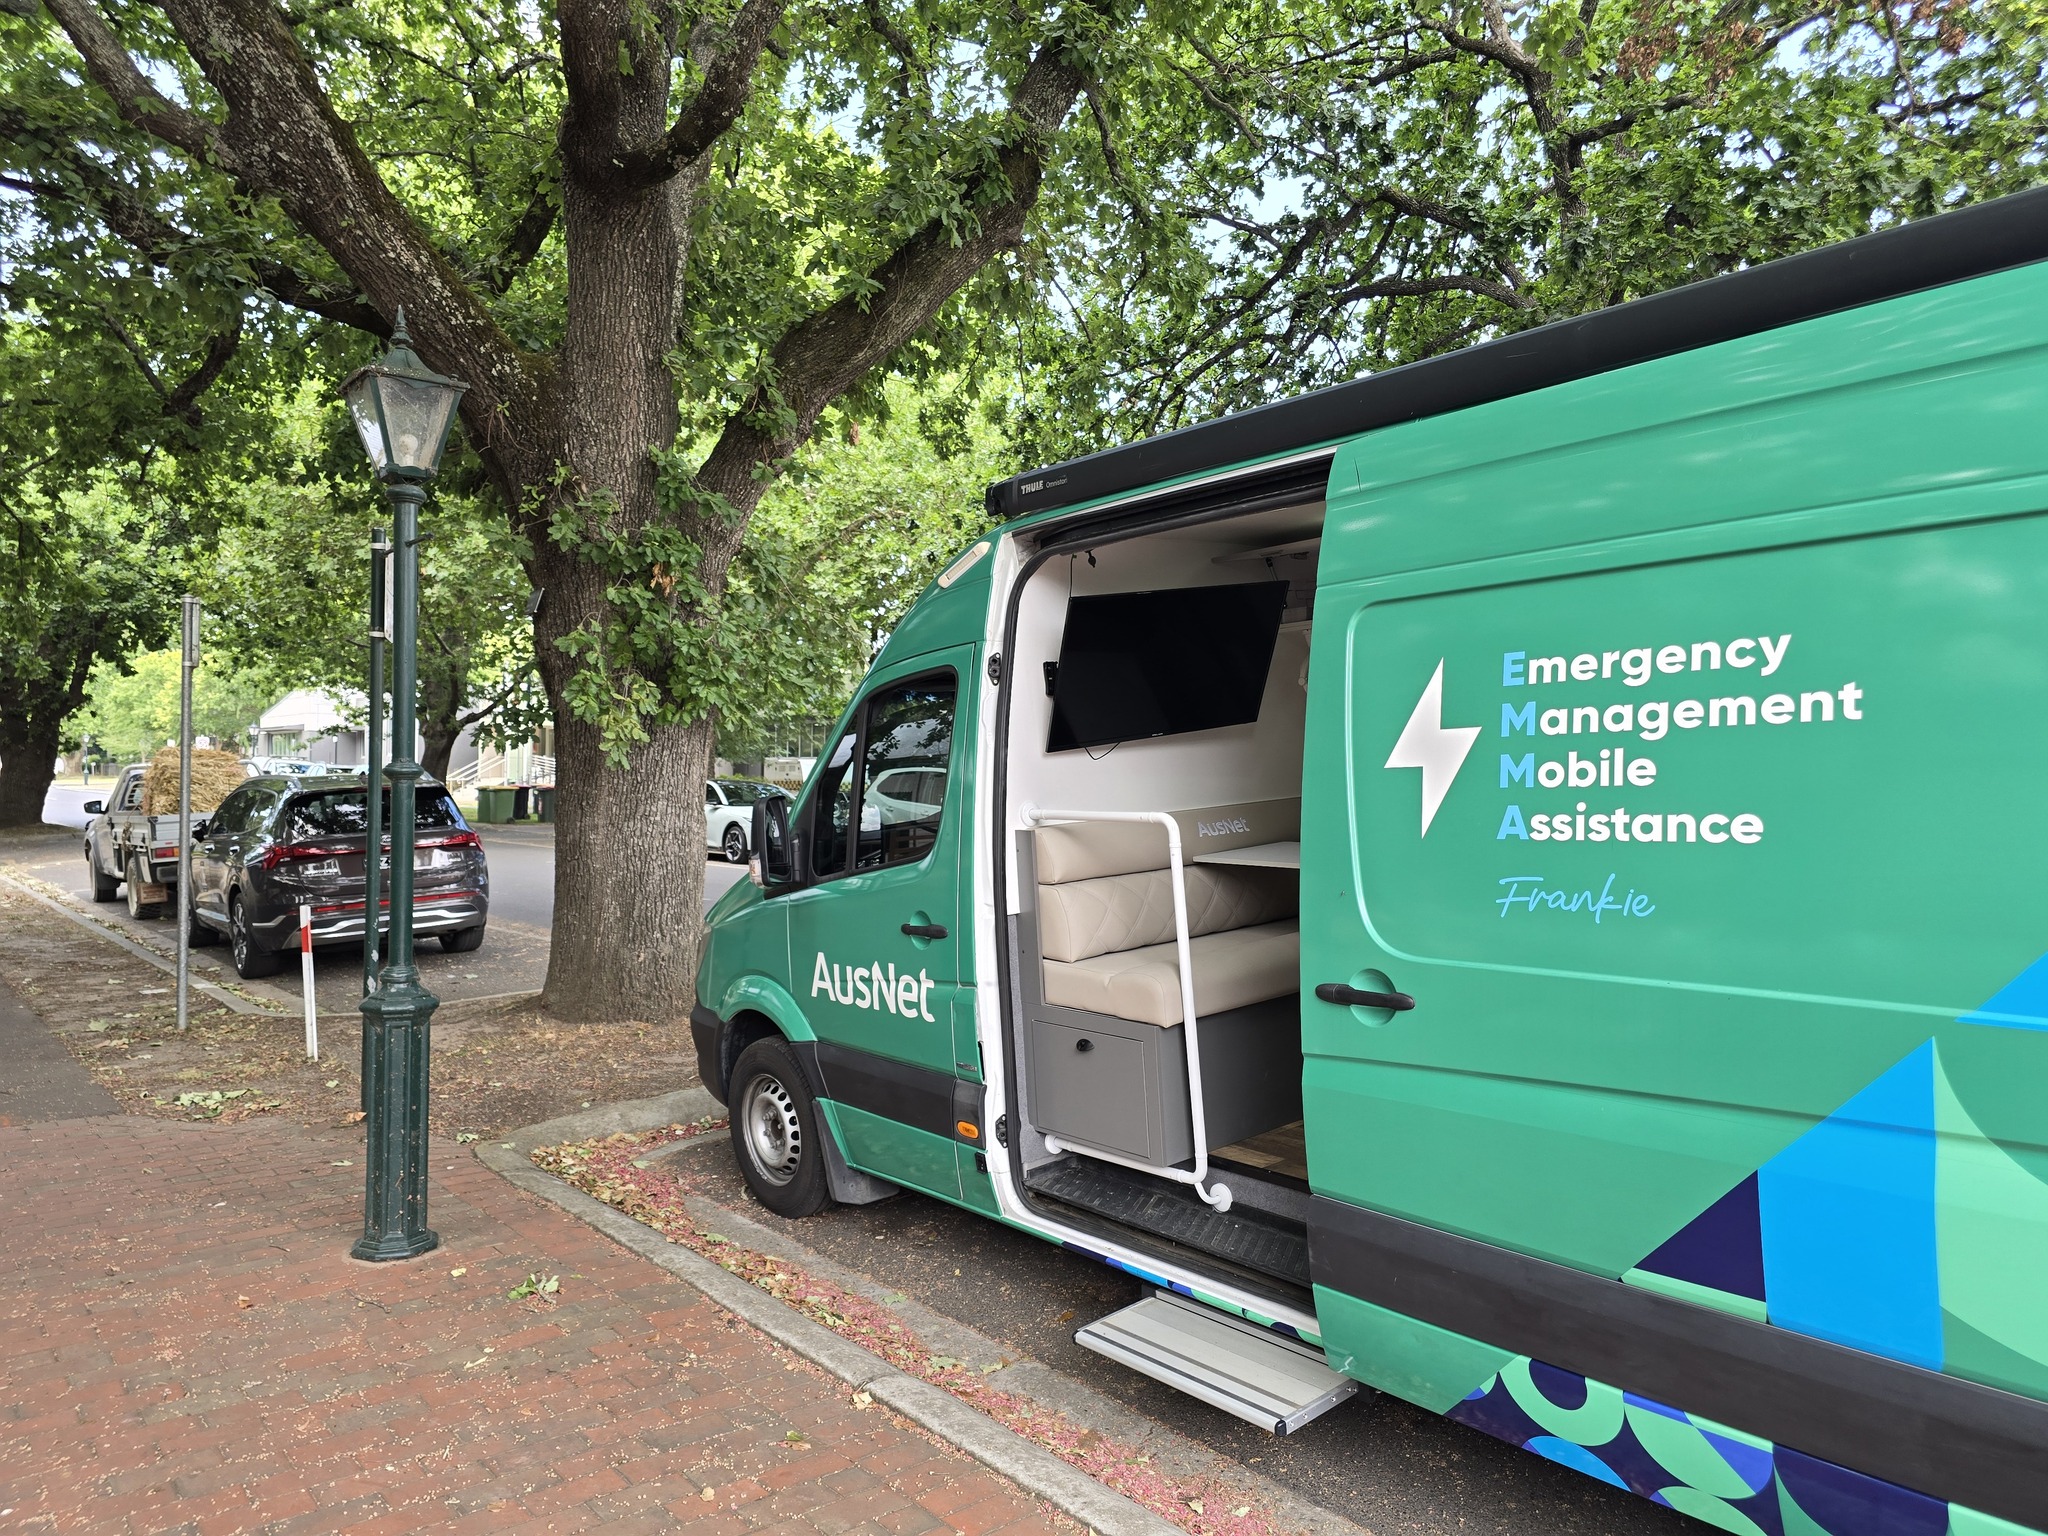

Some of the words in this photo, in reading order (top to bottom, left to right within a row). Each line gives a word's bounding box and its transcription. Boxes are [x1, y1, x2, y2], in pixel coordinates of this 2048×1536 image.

[1021, 480, 1044, 494] THULE
[1503, 633, 1792, 687] Emergency
[1501, 681, 1864, 741] Management
[1500, 748, 1657, 789] Mobile
[1198, 817, 1250, 838] AusNet
[1496, 801, 1764, 844] Assistance
[1495, 872, 1656, 924] Frankie
[811, 951, 936, 1023] AusNet
